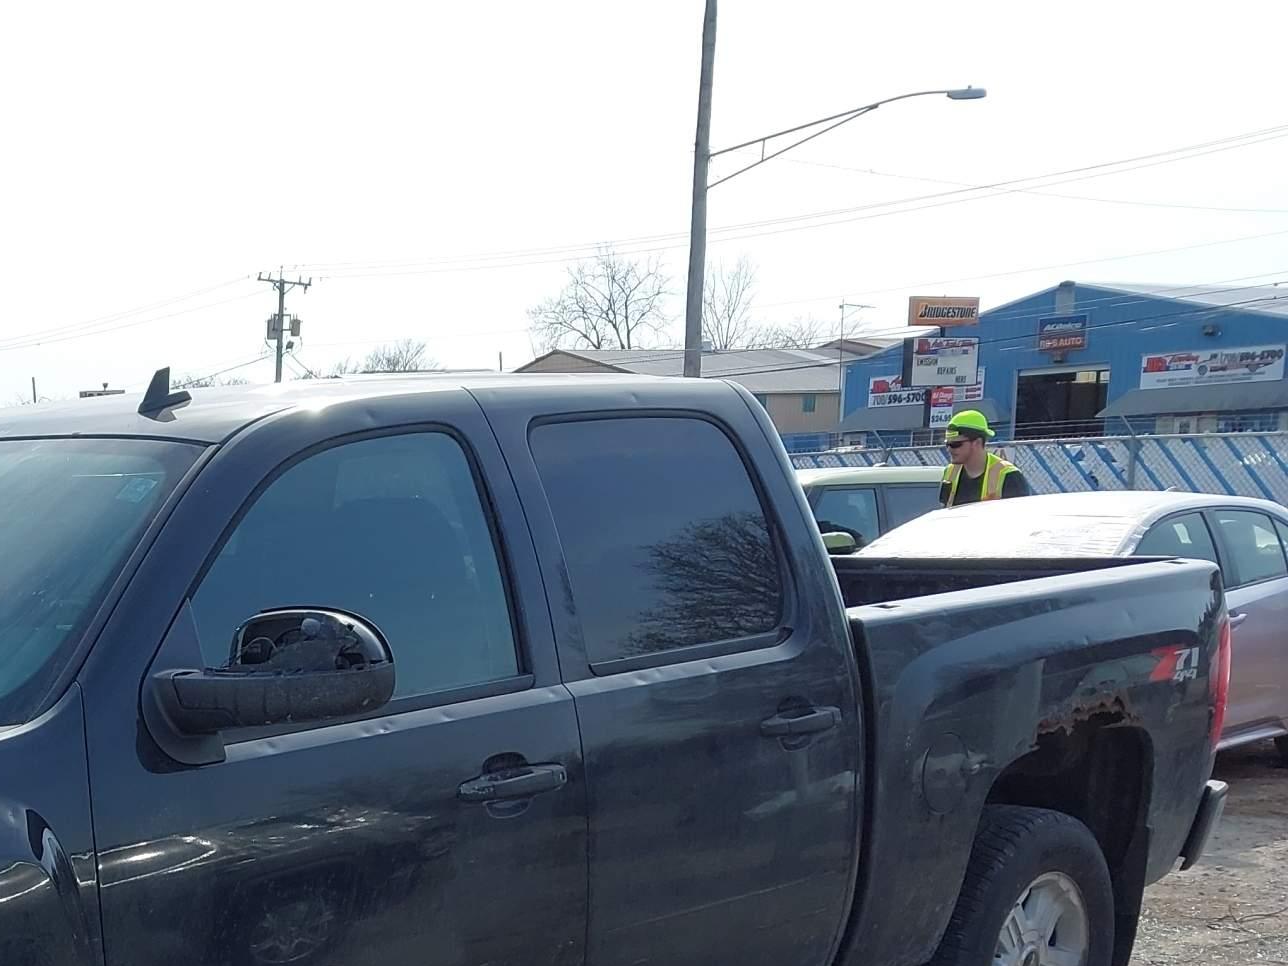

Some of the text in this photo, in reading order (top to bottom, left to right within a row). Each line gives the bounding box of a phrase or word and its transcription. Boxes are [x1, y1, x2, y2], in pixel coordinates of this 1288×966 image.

[919, 304, 976, 318] BRIDGESTONE
[1058, 337, 1083, 347] AUTO
[937, 367, 957, 376] REPAIRS
